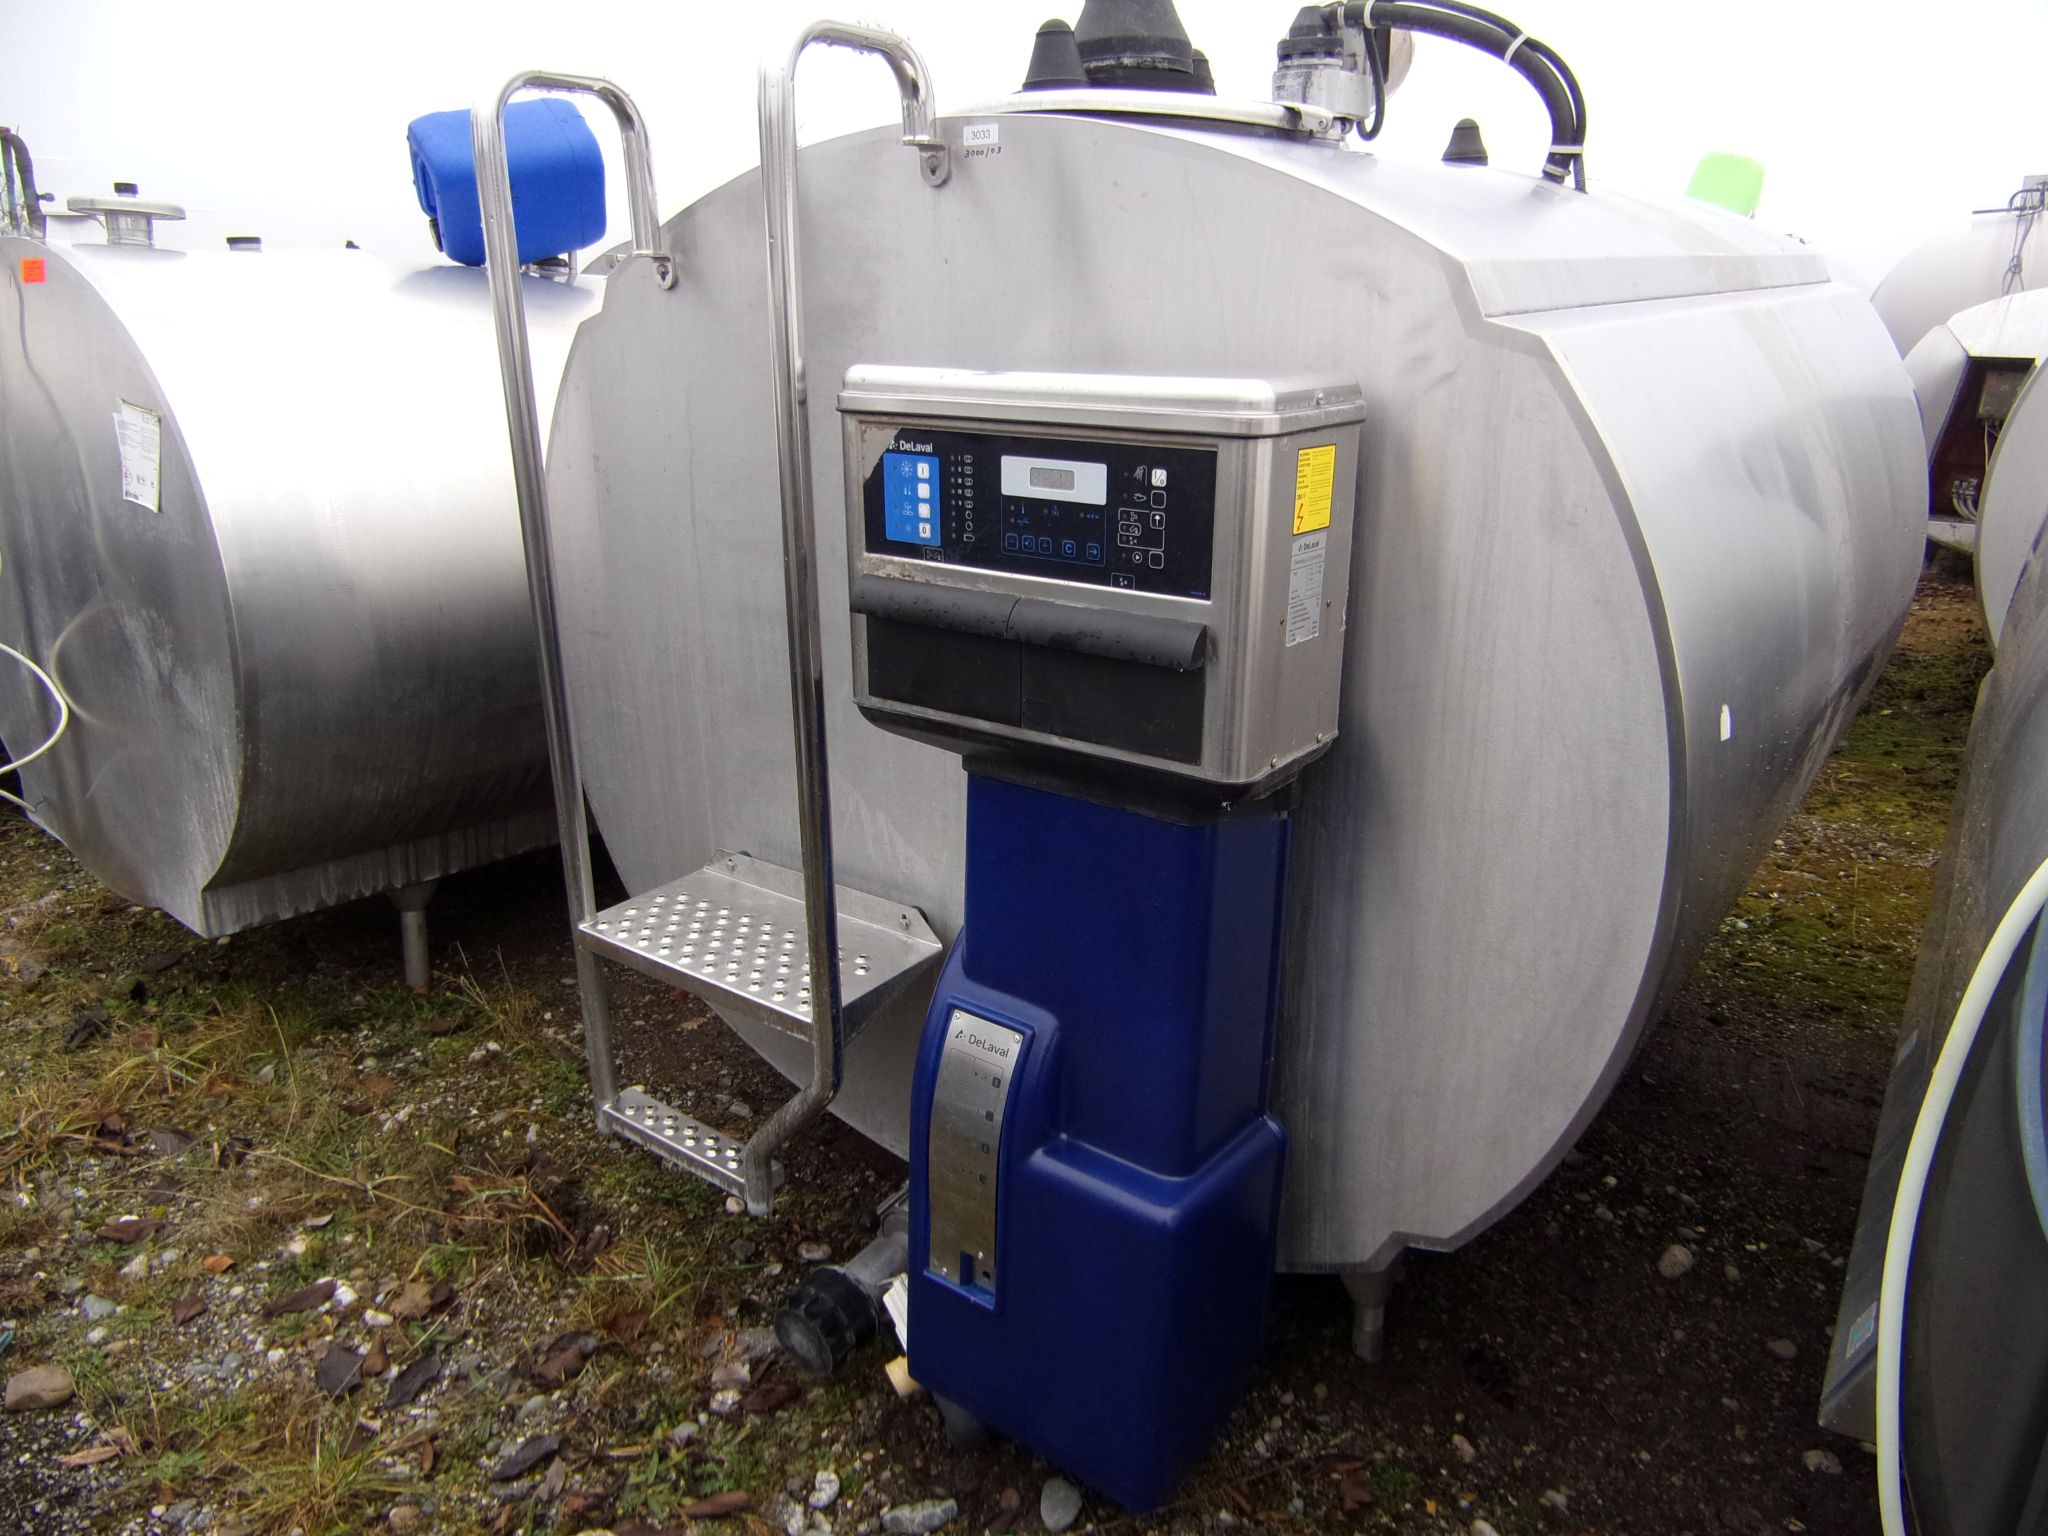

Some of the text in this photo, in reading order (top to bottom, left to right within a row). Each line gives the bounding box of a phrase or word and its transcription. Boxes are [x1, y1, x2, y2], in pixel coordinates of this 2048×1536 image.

[970, 129, 991, 141] 3033
[963, 146, 1002, 159] 3000/03
[899, 440, 933, 453] DeLaval
[968, 1033, 1010, 1058] DeLaval
